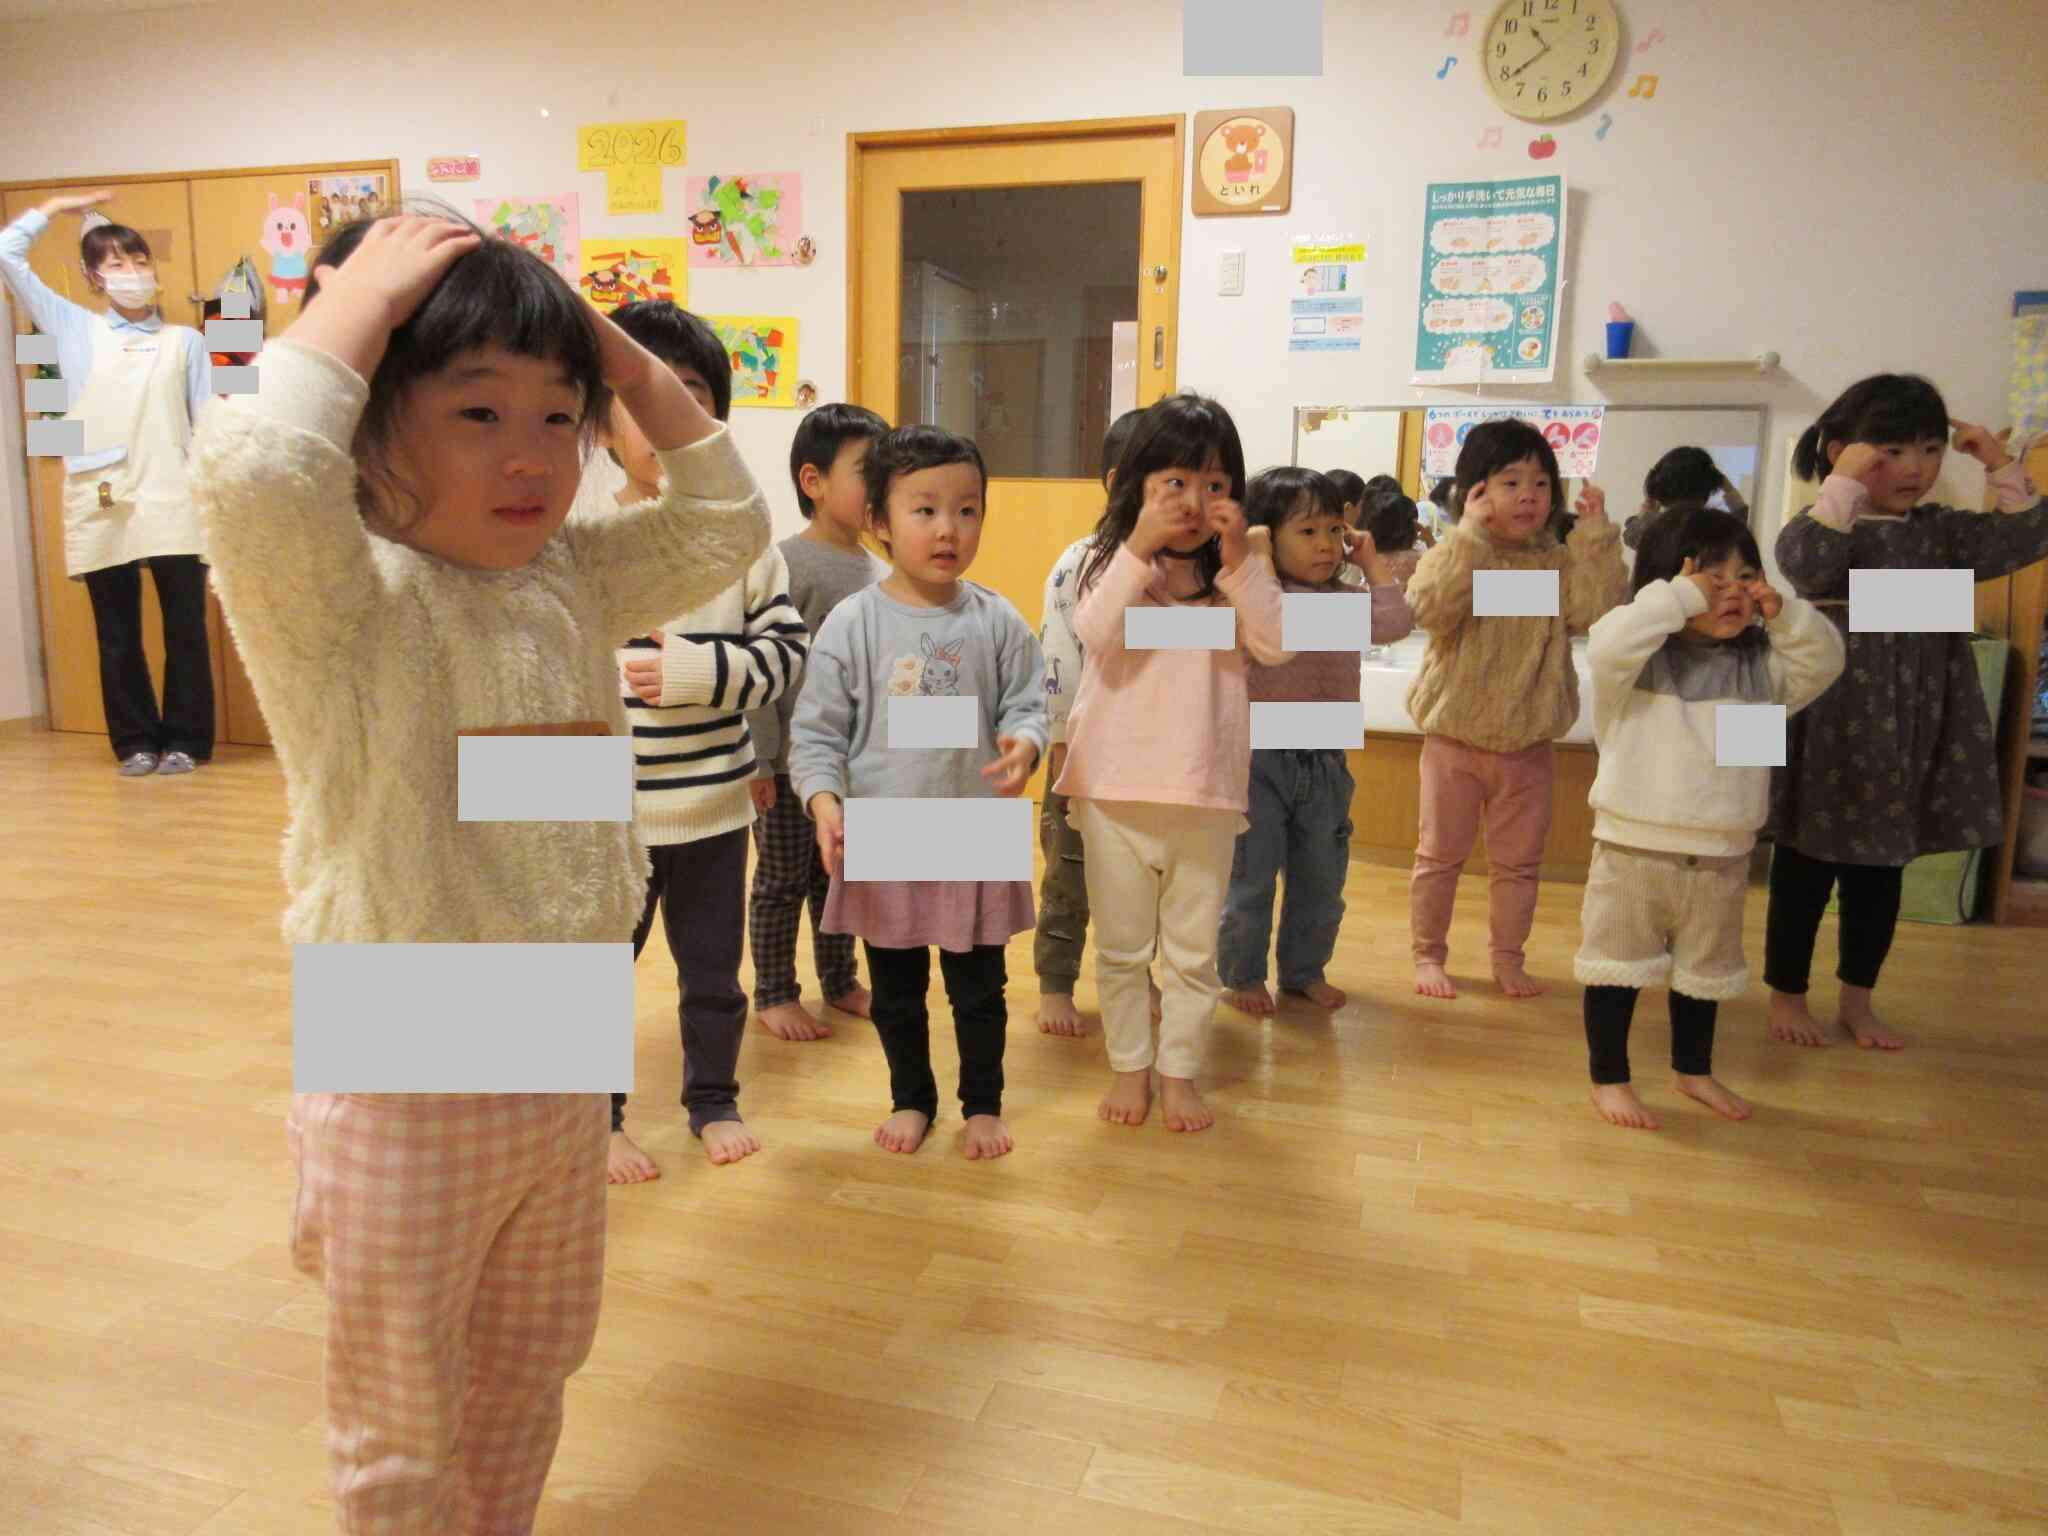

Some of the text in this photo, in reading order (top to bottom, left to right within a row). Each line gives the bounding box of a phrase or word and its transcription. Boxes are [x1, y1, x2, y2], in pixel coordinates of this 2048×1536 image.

[1504, 18, 1518, 34] 10
[1585, 15, 1596, 31] 2
[1496, 41, 1506, 58] 9
[1587, 38, 1599, 55] 3
[1500, 64, 1510, 81] 8
[1577, 62, 1588, 78] 4
[1514, 82, 1525, 97] 7
[1537, 86, 1548, 103] 6
[1561, 80, 1571, 97] 5
[587, 127, 683, 166] 2026
[1219, 184, 1261, 197] といれ
